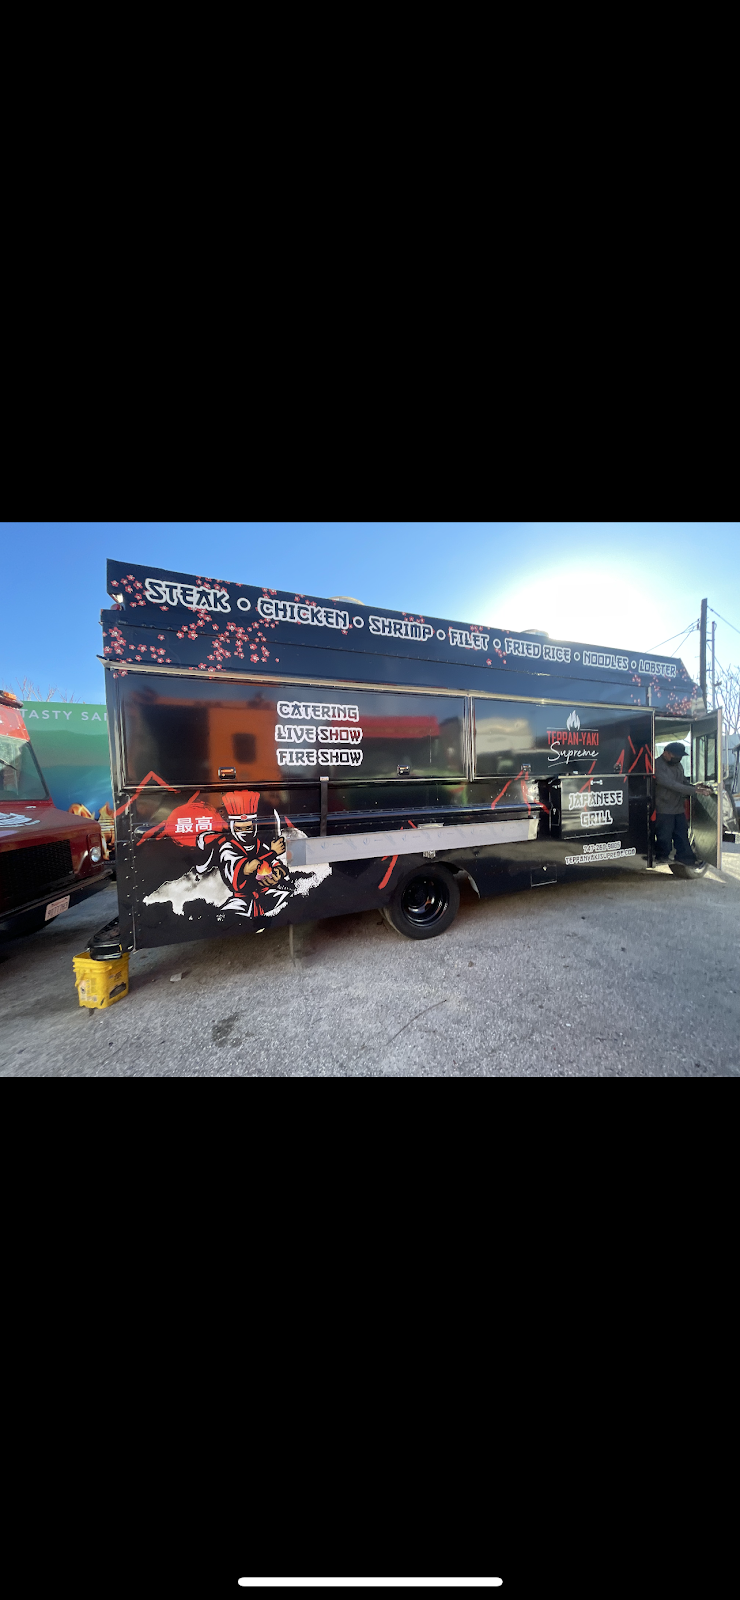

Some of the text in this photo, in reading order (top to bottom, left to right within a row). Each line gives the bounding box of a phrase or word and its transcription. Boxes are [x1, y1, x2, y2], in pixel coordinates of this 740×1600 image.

[145, 578, 676, 677] STEAK CHICKEN SHRIMP FILET FRIED RICE NOODLES LOBSTER
[21, 709, 107, 721] TASTY SA
[277, 701, 360, 722] CATERING
[275, 724, 363, 744] LIVE SHOW
[546, 730, 599, 746] TEPPAN-YAKI
[276, 748, 363, 766] FIRE SHOW
[547, 741, 599, 764] Supreme
[569, 790, 623, 810] JAPANESE
[175, 816, 213, 833] 最高
[580, 810, 613, 827] GRILL
